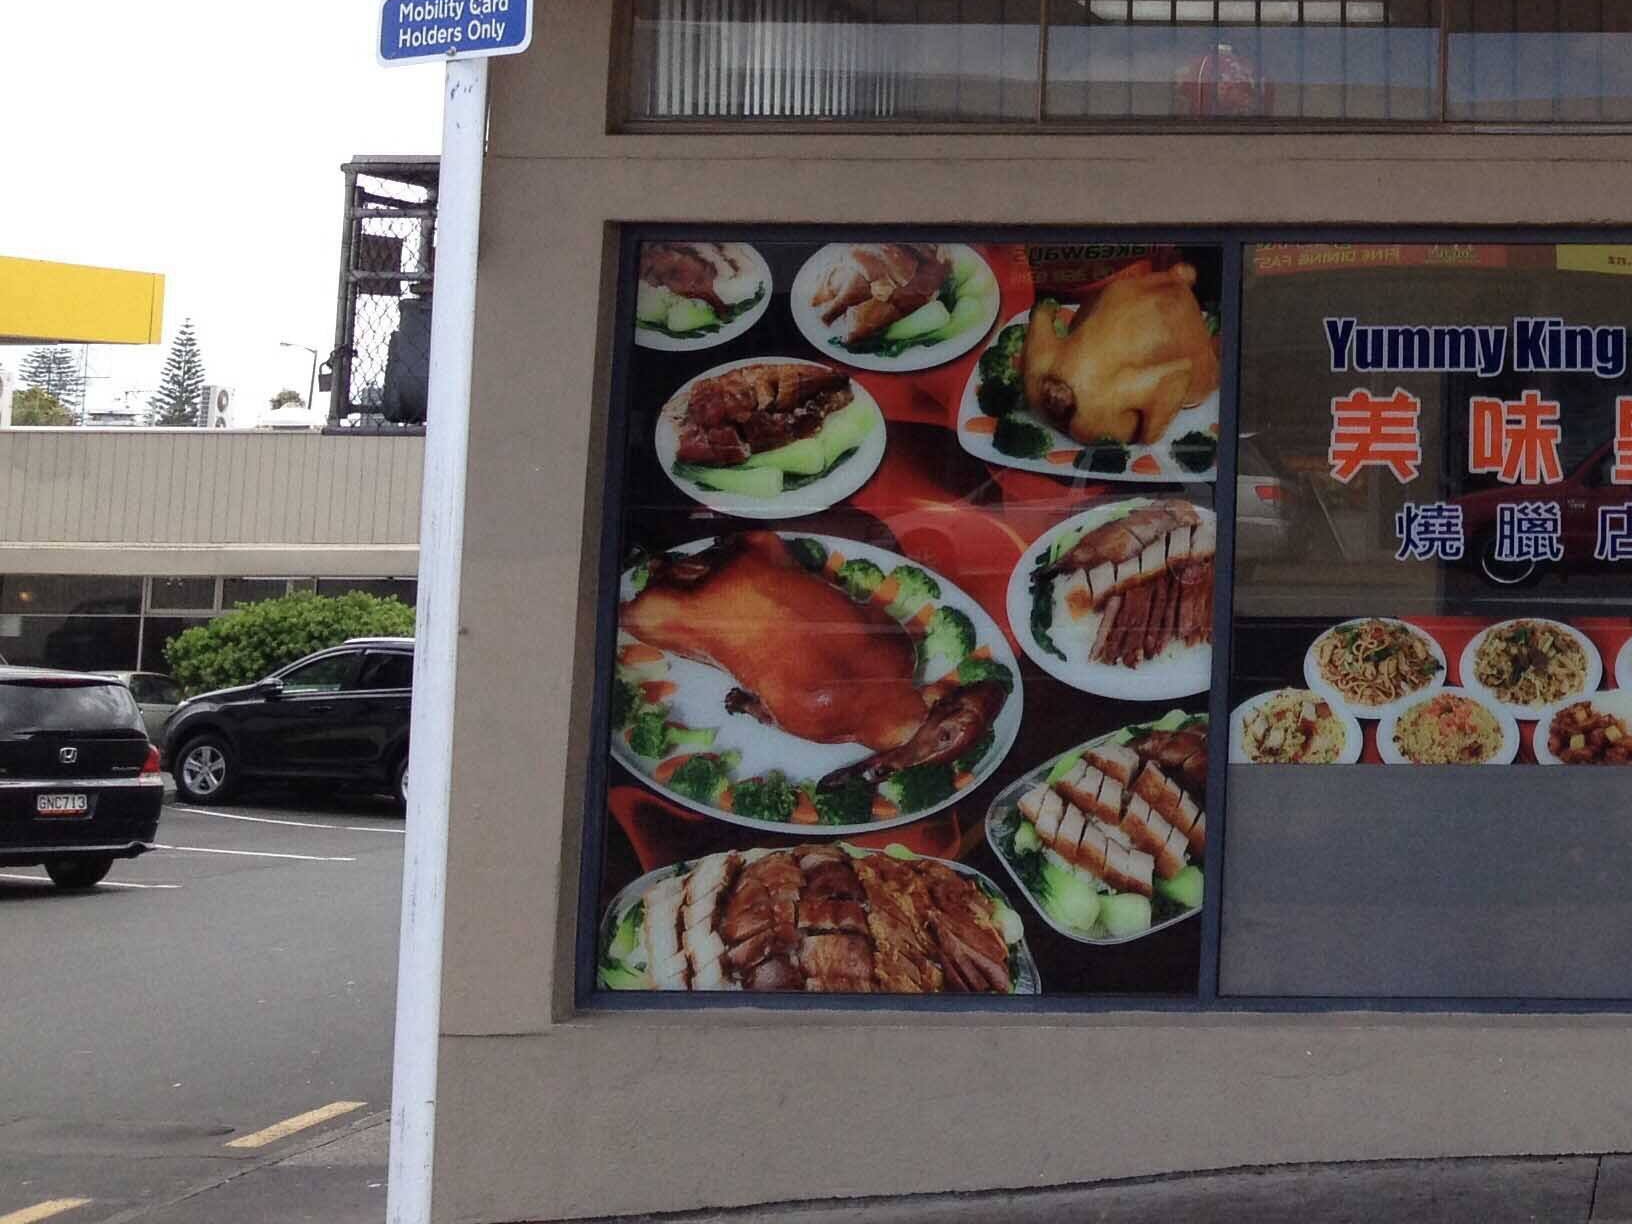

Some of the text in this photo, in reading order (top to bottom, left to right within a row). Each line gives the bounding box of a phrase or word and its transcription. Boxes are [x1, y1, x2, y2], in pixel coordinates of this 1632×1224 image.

[398, 18, 506, 48] Holders Only
[1324, 317, 1506, 377] Yummy
[1512, 317, 1626, 377] King
